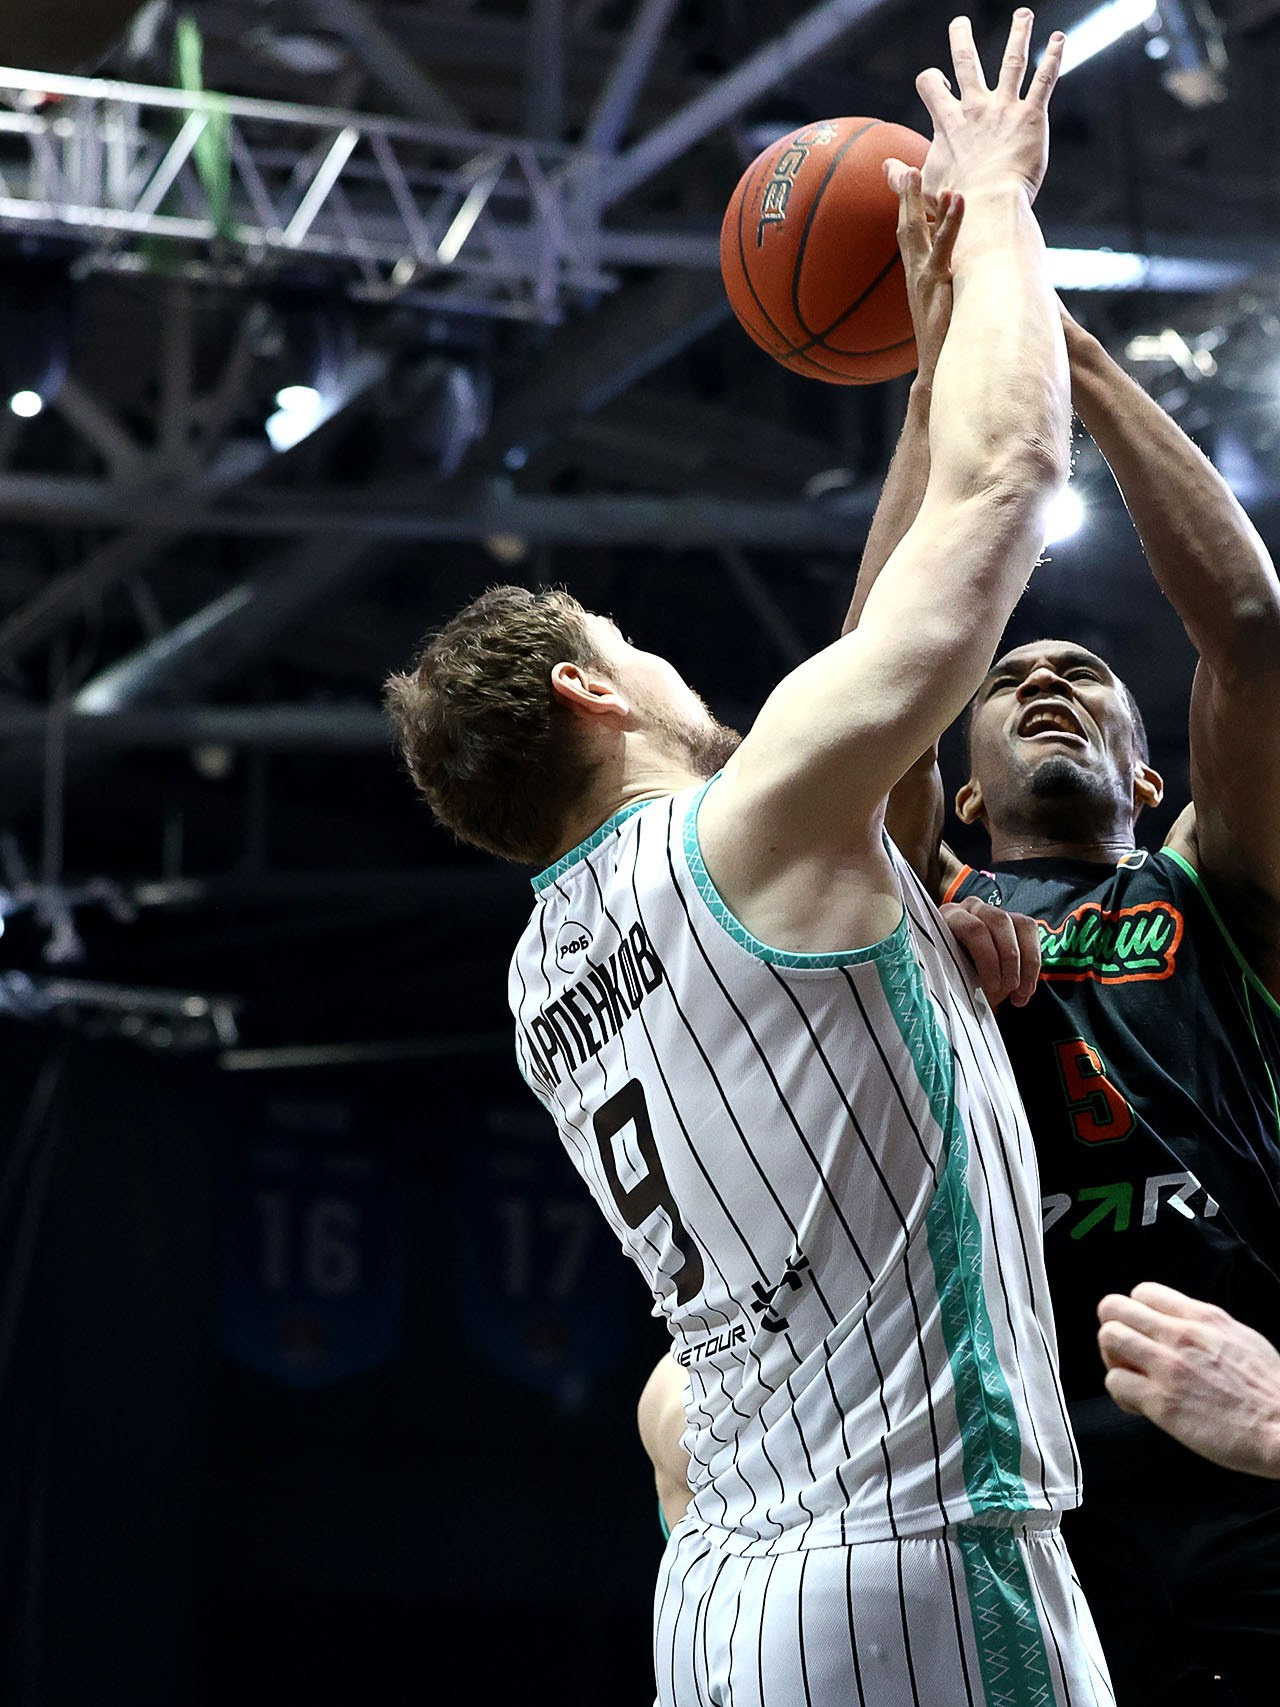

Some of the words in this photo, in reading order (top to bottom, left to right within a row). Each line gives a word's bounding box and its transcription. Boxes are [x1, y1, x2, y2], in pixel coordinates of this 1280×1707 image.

[560, 935, 590, 960] РФБ
[524, 921, 664, 1090] АРПЕНКОВ
[1054, 1036, 1138, 1147] 5
[254, 1190, 362, 1297] 16
[592, 1077, 705, 1307] 9
[494, 1196, 597, 1298] 17
[677, 1324, 748, 1368] ETOUR
